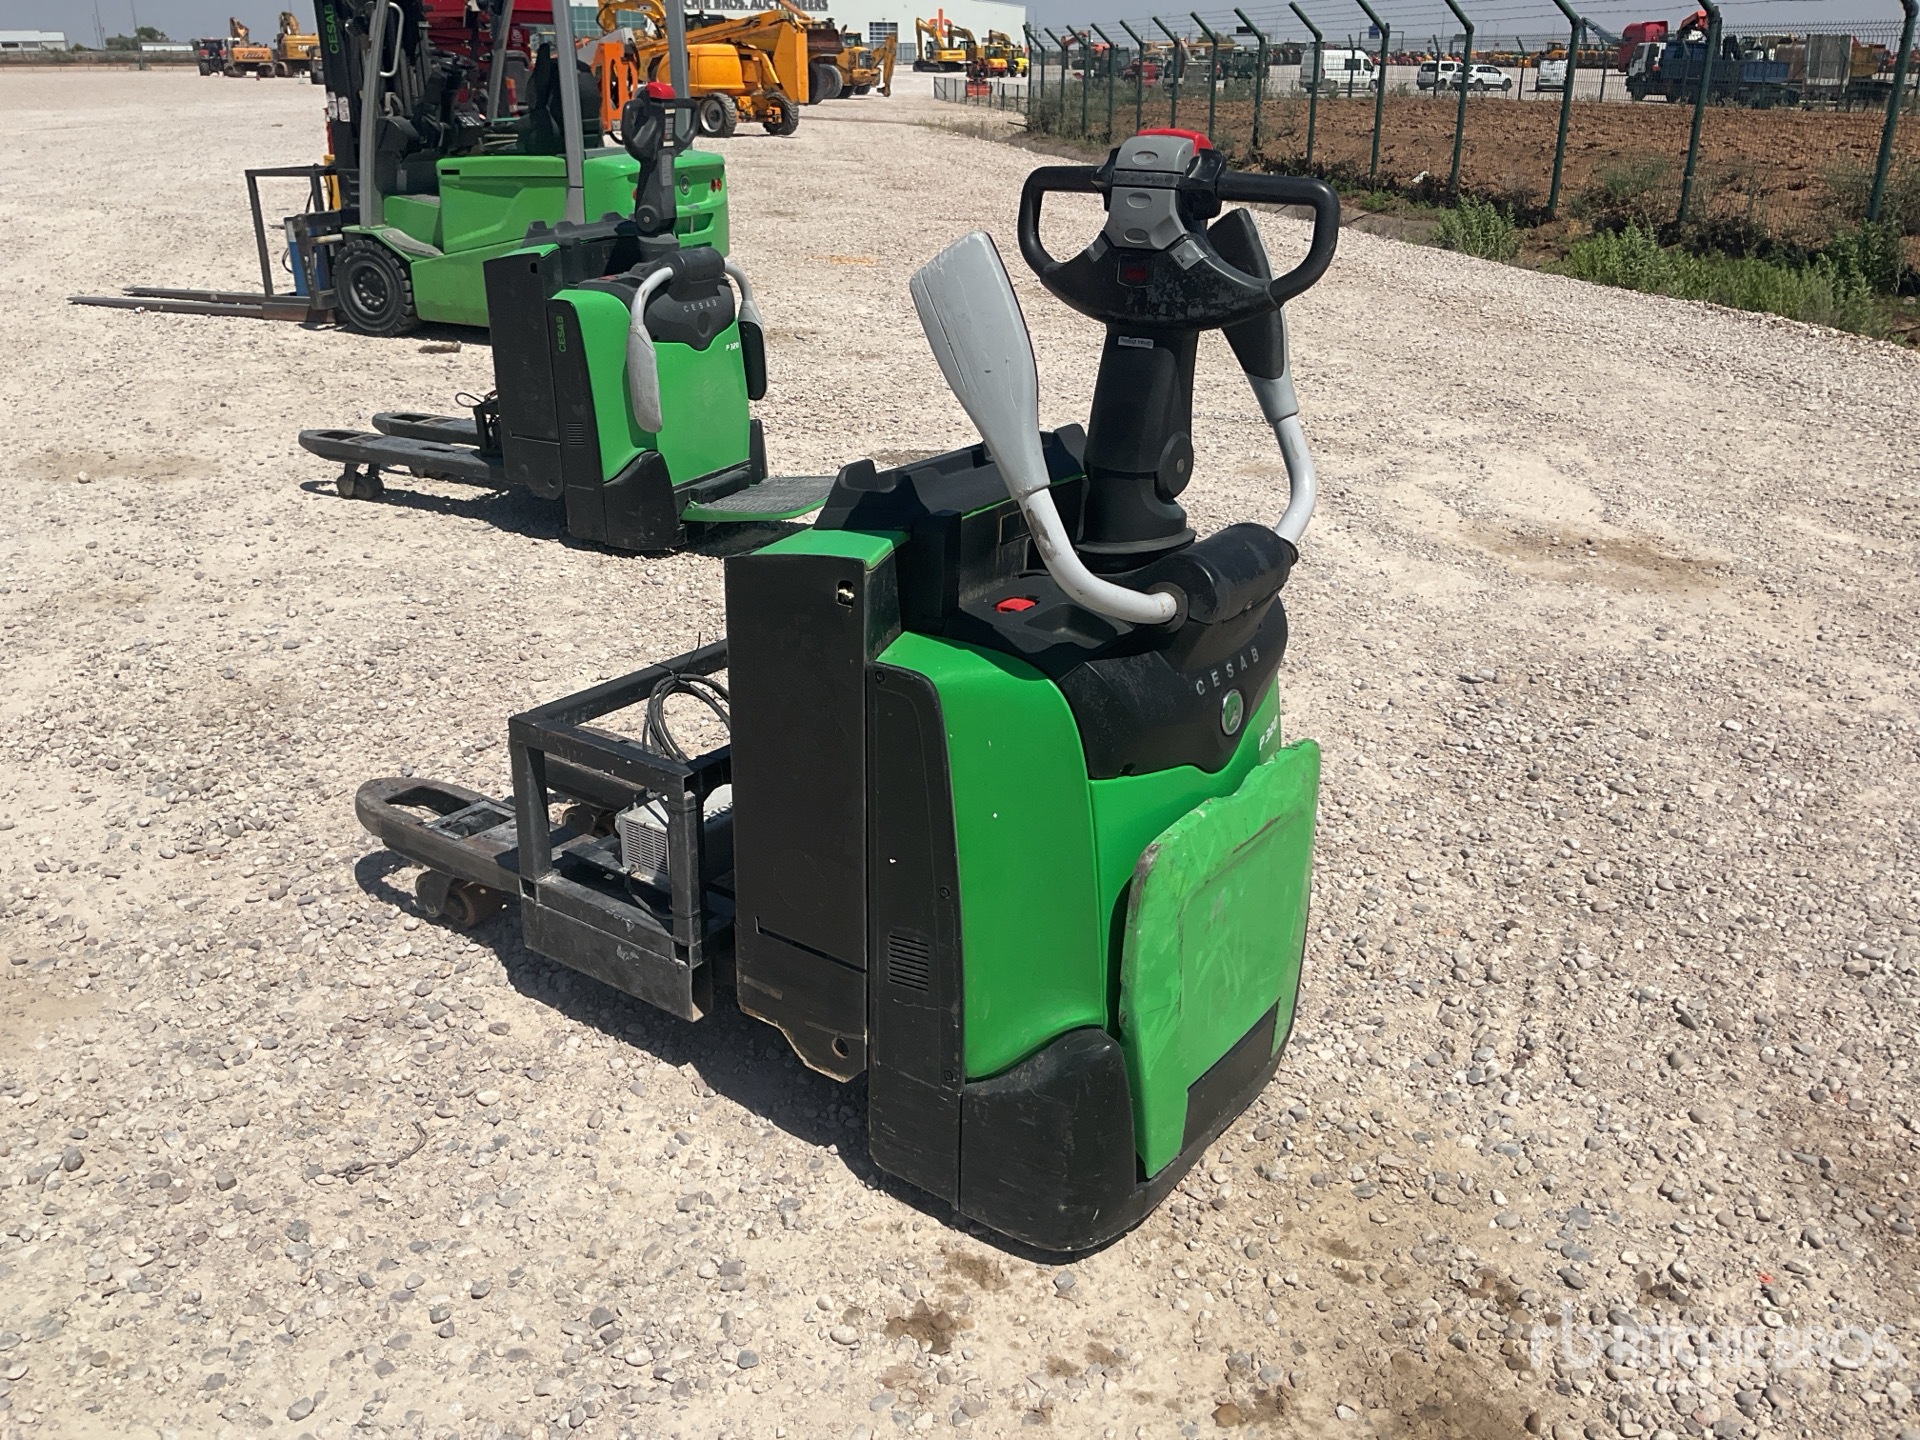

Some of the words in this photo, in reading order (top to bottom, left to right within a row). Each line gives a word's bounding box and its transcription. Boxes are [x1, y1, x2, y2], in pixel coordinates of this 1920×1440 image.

[324, 4, 339, 54] CESAB
[684, 299, 717, 313] CESAB
[556, 315, 567, 352] CESAB
[1195, 647, 1259, 696] CESAB
